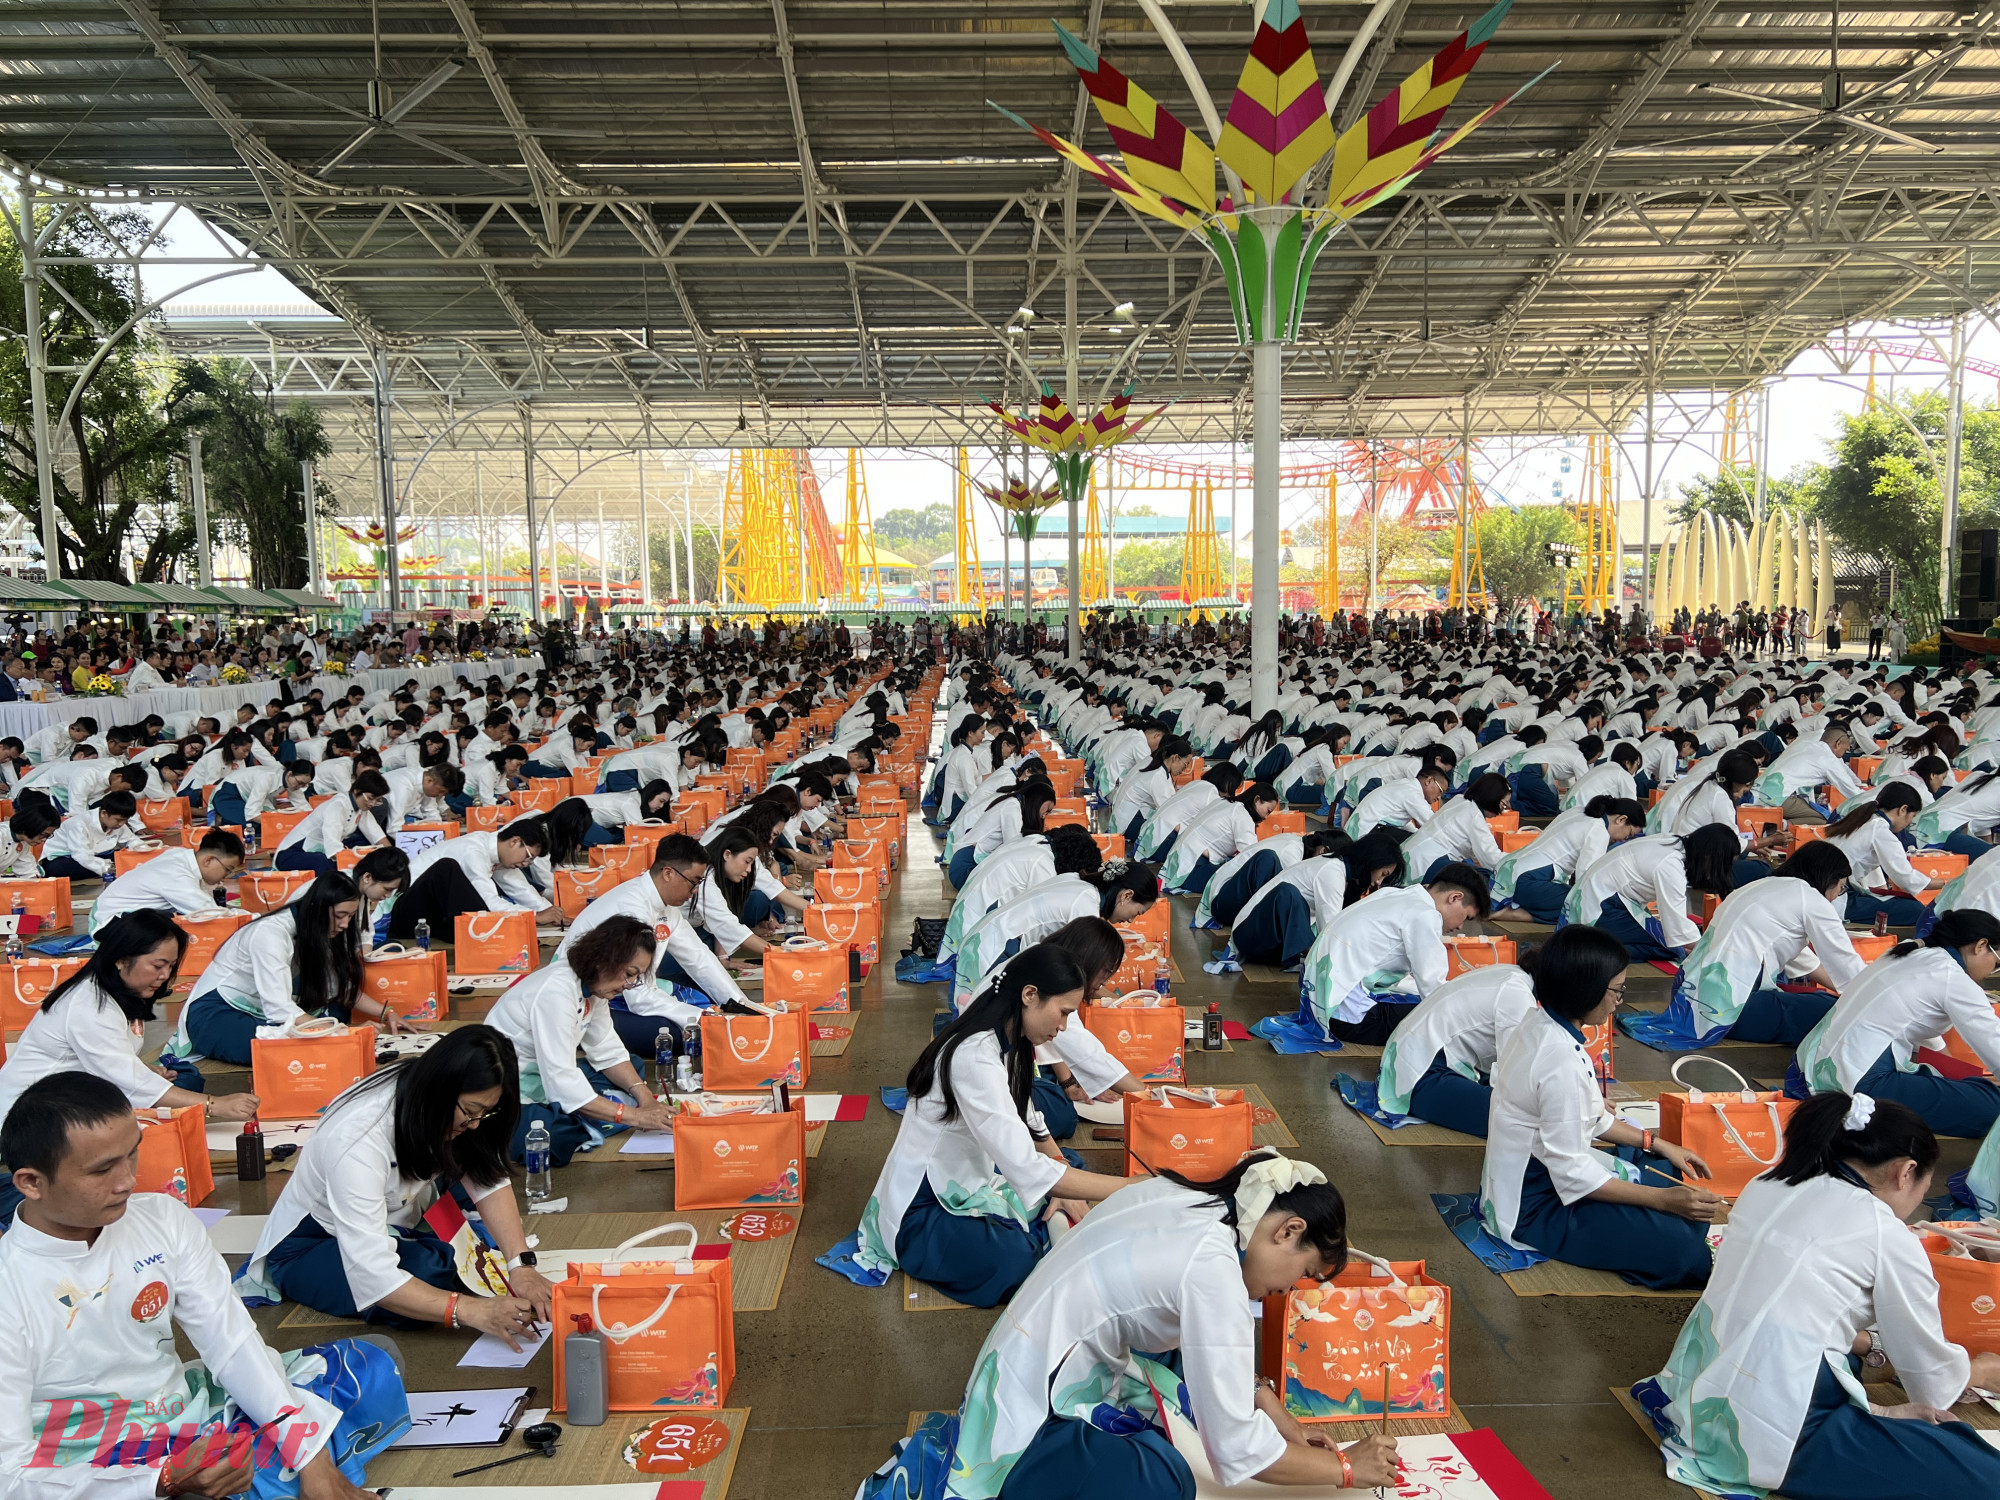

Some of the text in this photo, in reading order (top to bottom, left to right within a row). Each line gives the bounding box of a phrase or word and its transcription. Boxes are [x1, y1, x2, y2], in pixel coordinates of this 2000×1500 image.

[738, 1214, 767, 1236] 652
[140, 1296, 163, 1316] 651
[648, 1424, 696, 1464] 651
